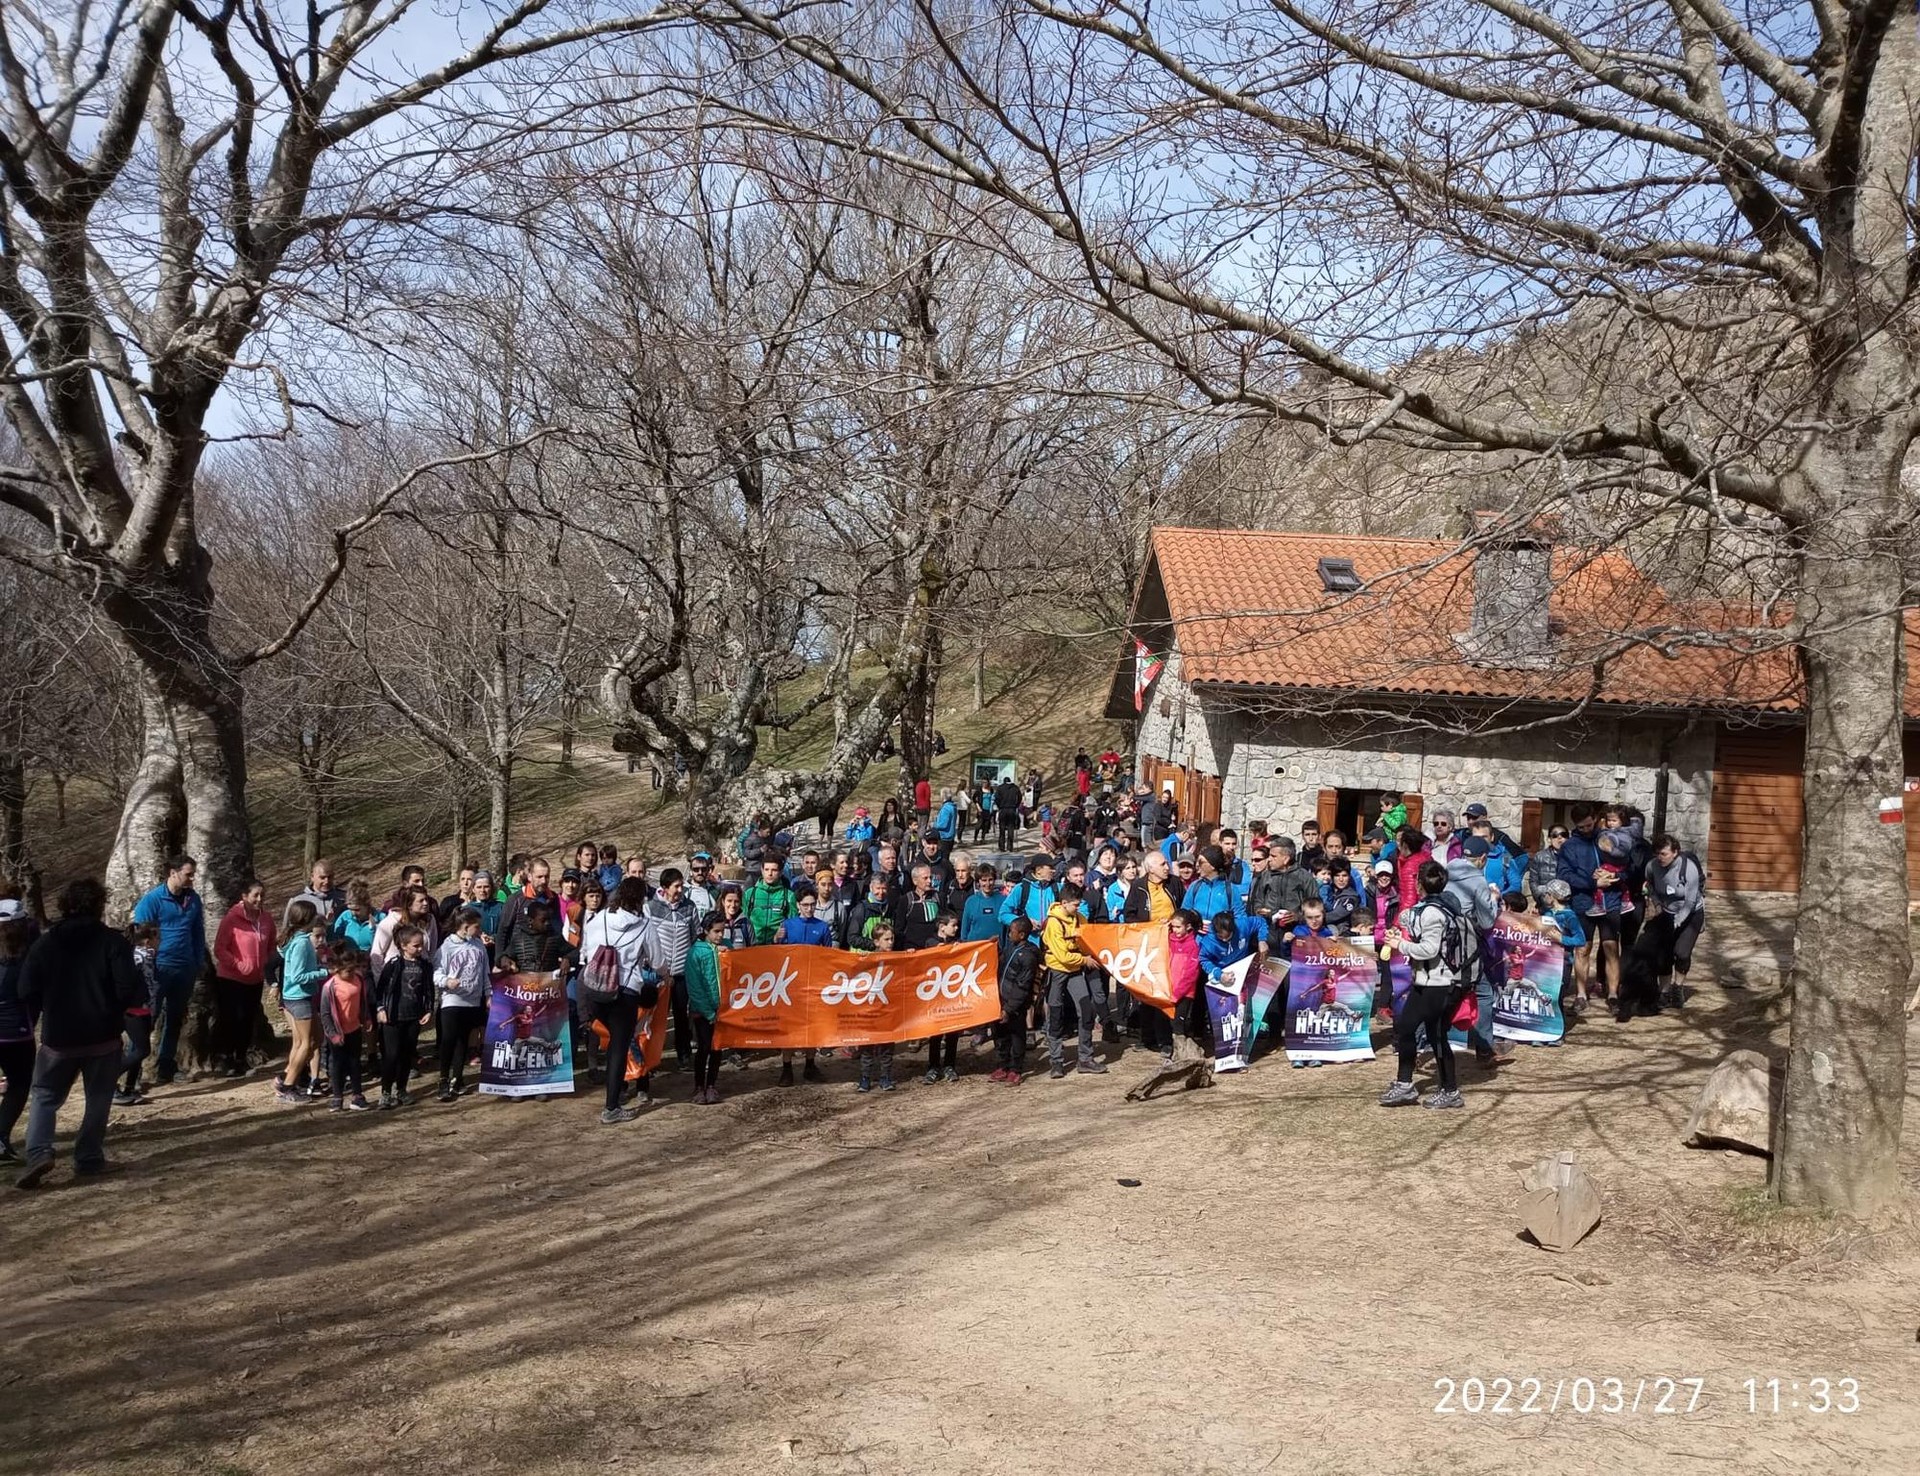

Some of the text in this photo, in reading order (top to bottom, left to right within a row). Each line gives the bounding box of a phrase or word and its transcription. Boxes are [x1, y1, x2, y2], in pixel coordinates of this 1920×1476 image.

[729, 956, 799, 1010] aek
[820, 960, 895, 1005] aek
[916, 950, 988, 1001] aek
